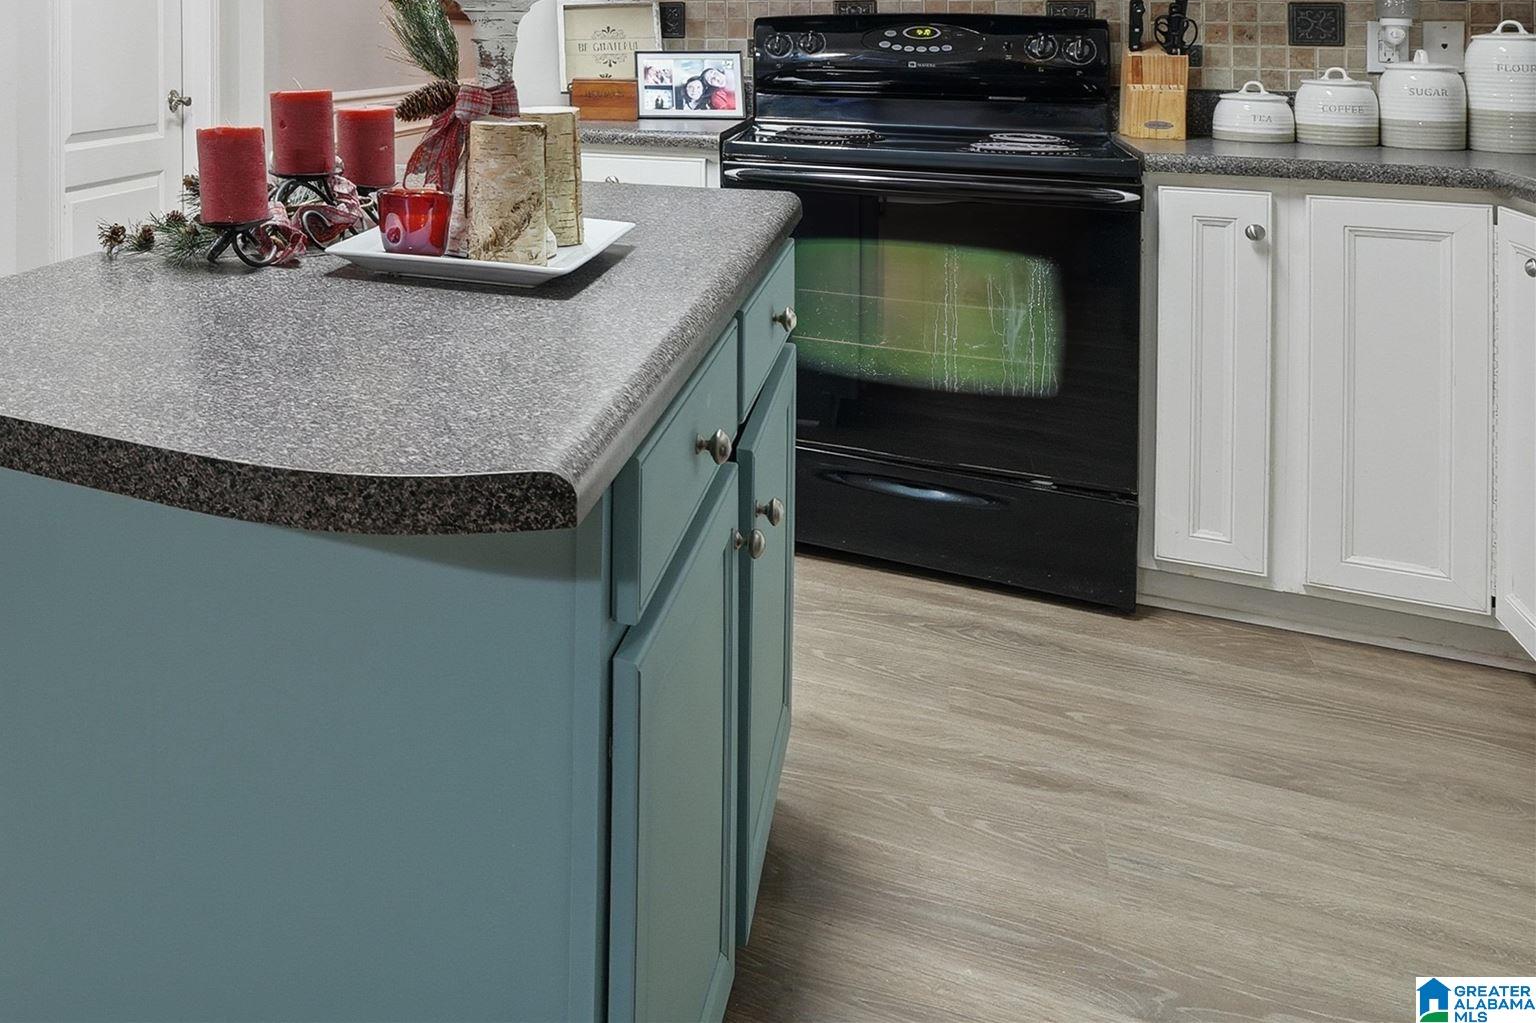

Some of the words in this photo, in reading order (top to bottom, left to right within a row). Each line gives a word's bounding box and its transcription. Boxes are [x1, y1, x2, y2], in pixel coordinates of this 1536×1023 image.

[1496, 63, 1536, 74] FLOUR
[1407, 87, 1450, 98] SUGAR
[1320, 103, 1365, 115] COFFEE
[1252, 113, 1273, 124] TEA
